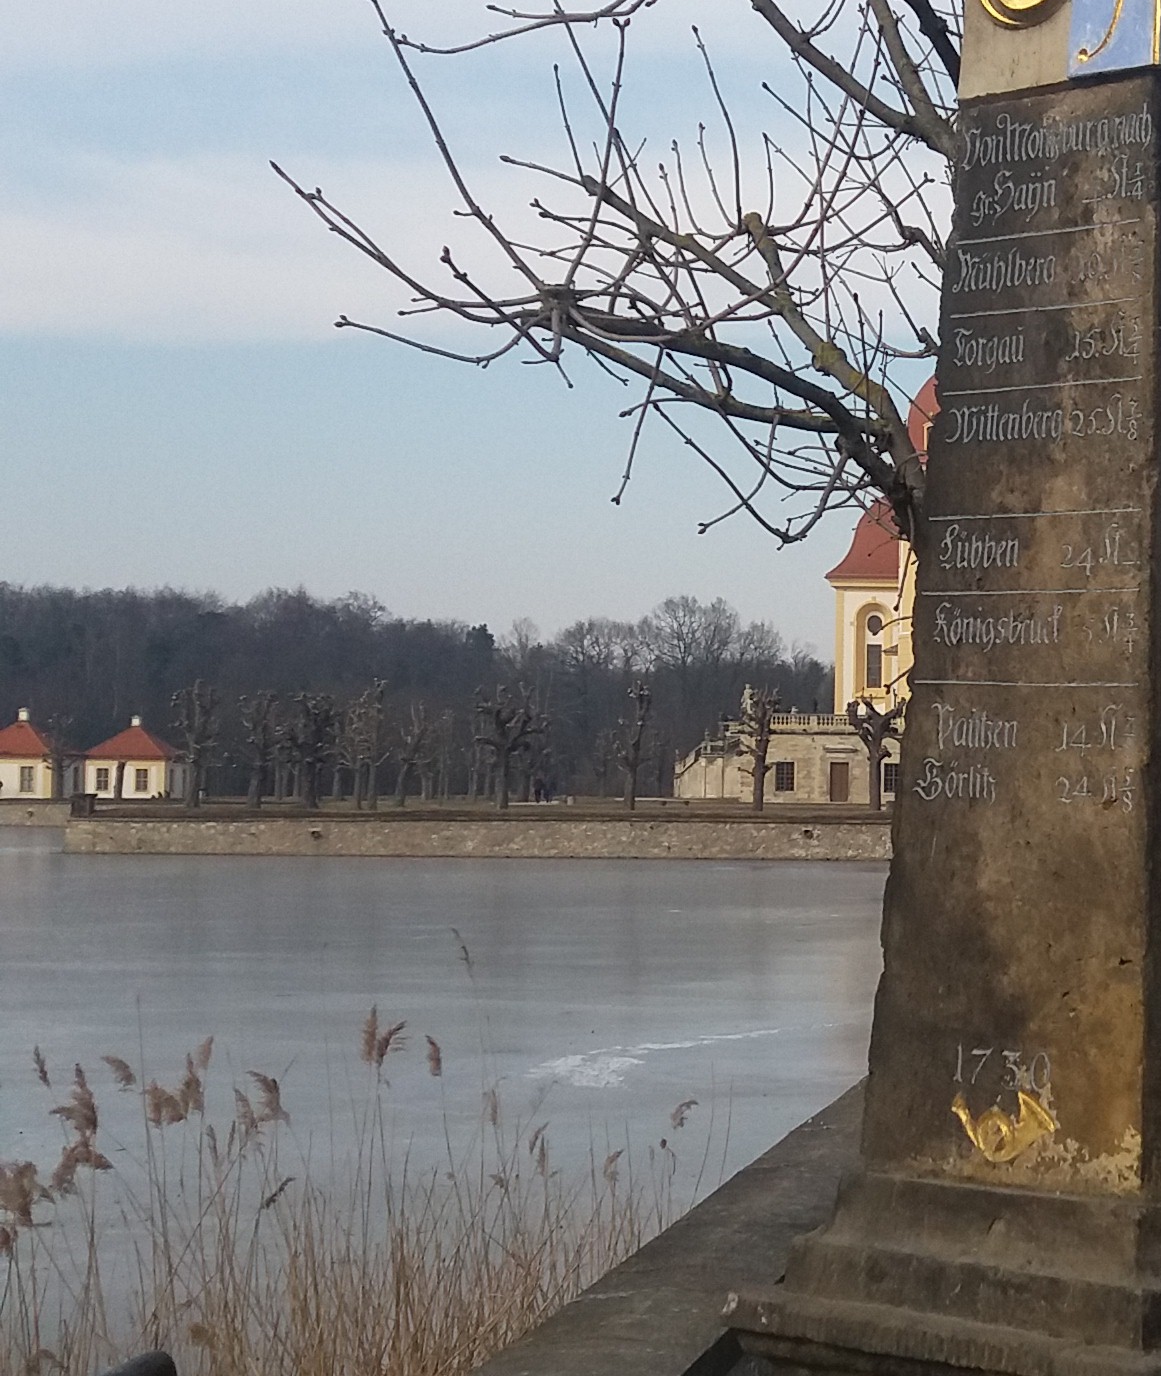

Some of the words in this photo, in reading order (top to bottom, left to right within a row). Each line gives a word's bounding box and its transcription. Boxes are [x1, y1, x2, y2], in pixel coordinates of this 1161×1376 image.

[953, 326, 1025, 374] Torgau
[945, 398, 1064, 443] Wittenberg
[939, 524, 1020, 570] Lübben
[912, 756, 997, 805] Görlitz
[952, 1042, 1051, 1093] 1730
